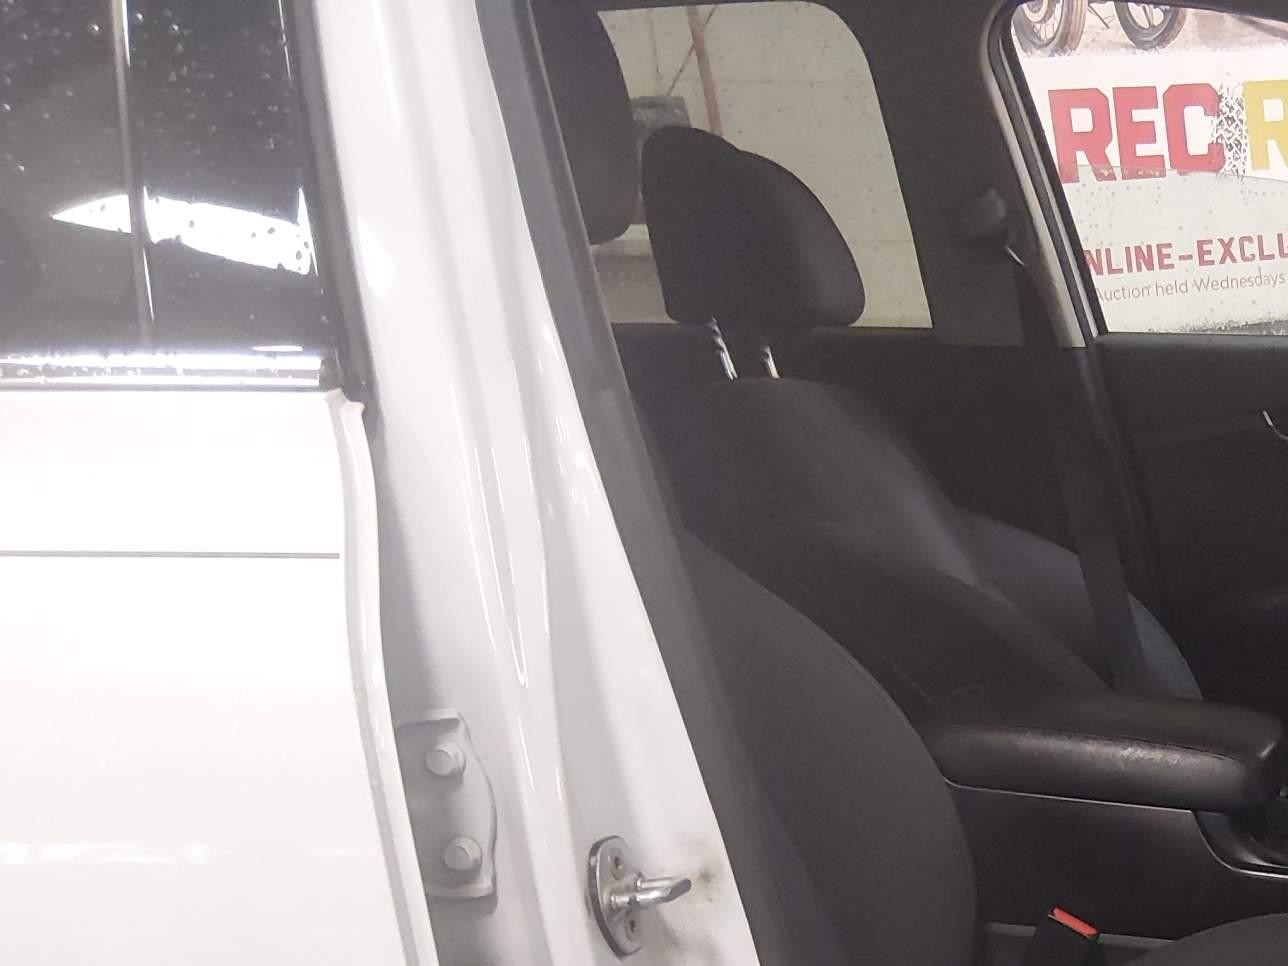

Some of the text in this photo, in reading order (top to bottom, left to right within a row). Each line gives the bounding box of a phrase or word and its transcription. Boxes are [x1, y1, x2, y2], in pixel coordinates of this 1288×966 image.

[1048, 83, 1226, 184] REC
[1155, 279, 1189, 297] held
[1193, 270, 1286, 293] Wednesdays
